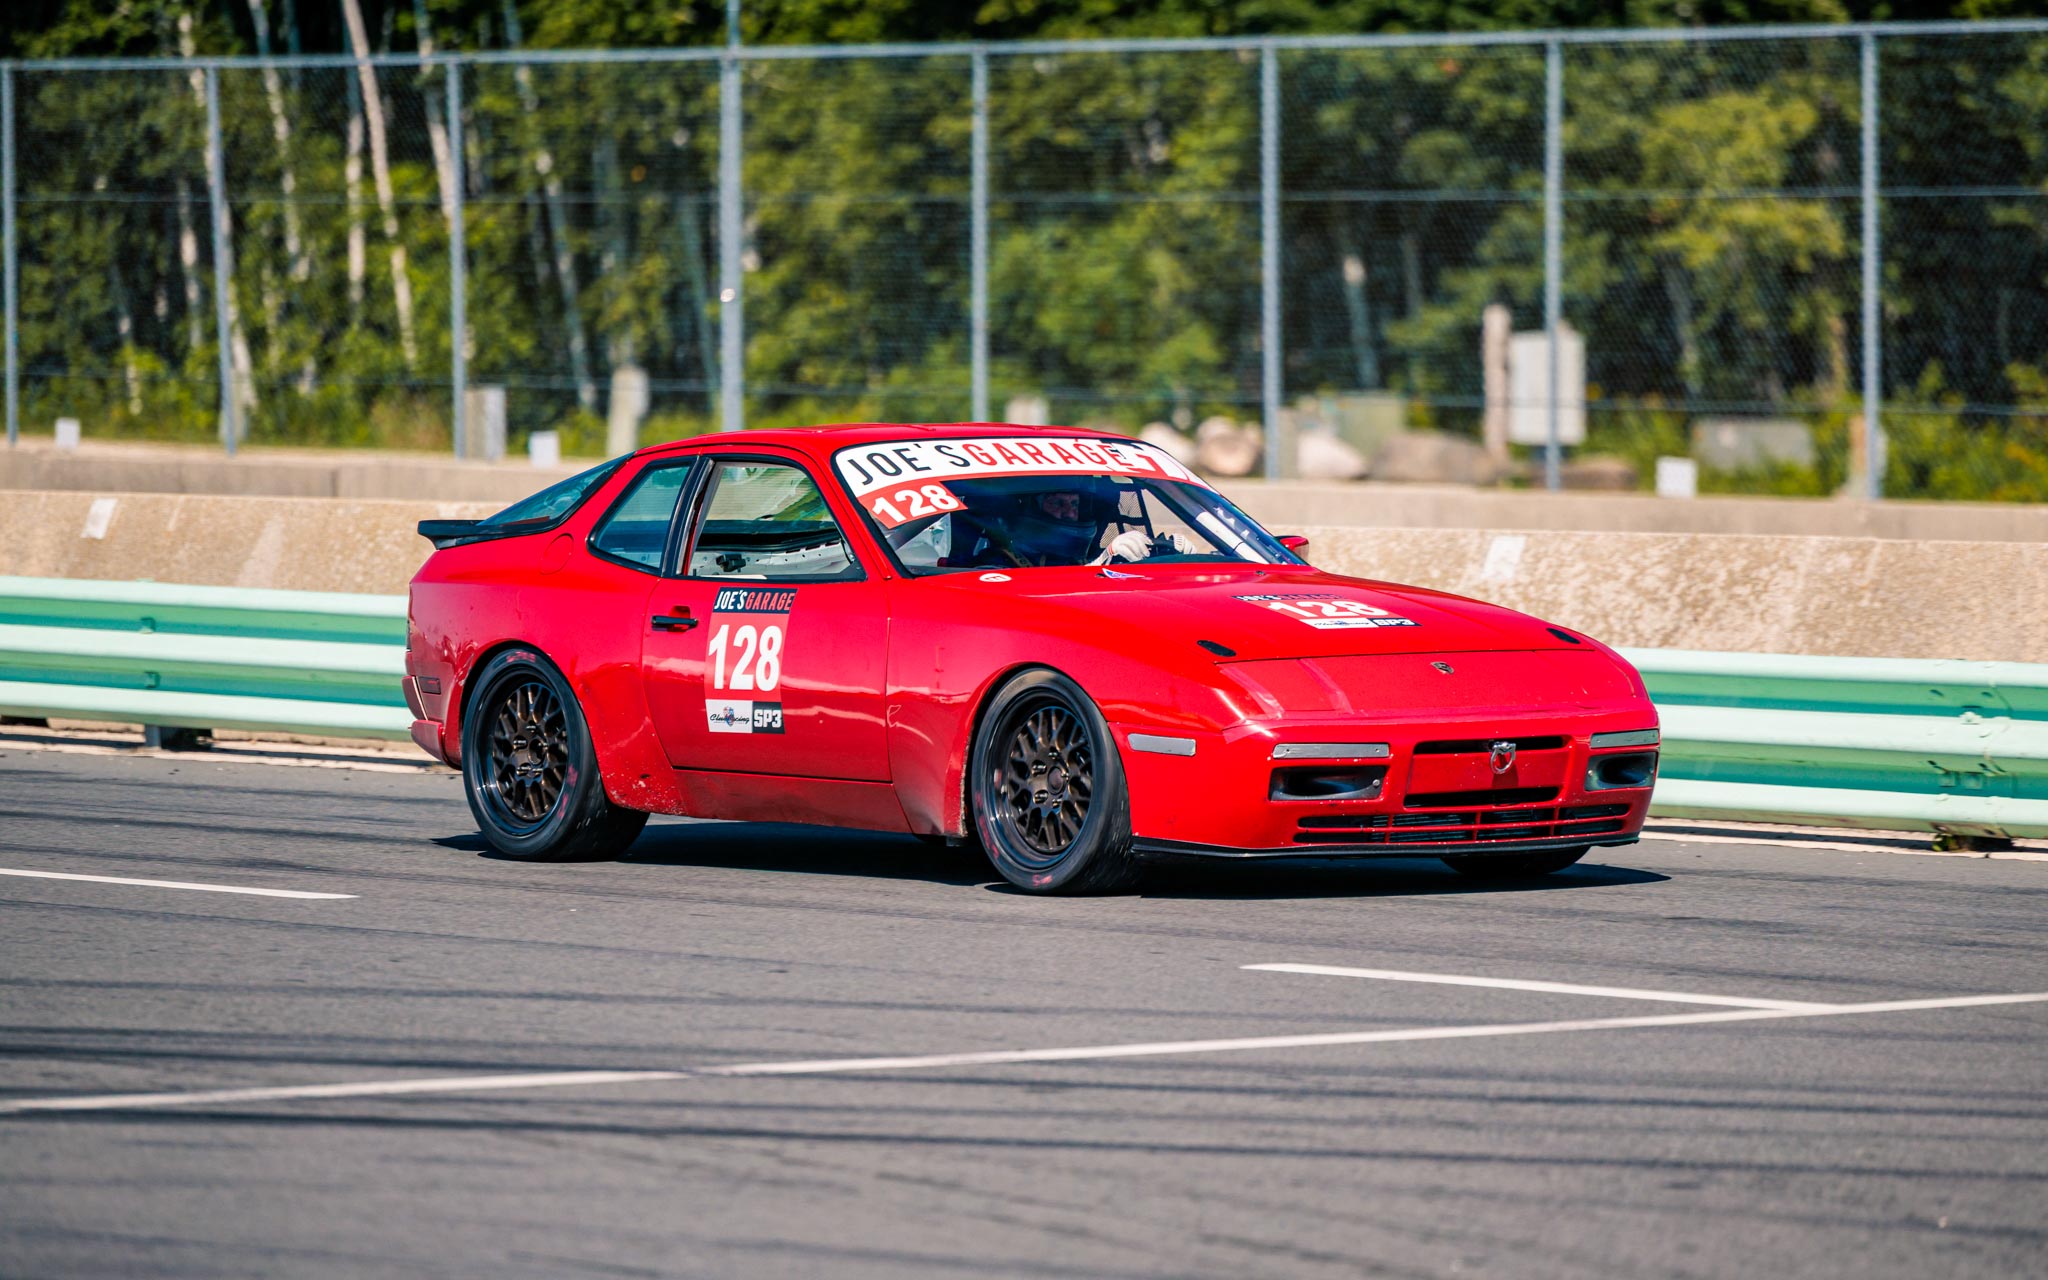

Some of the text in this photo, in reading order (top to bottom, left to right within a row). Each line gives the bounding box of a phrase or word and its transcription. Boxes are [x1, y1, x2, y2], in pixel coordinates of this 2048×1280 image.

[871, 484, 959, 523] 128
[1268, 600, 1388, 617] 128
[708, 624, 782, 692] 128
[754, 708, 782, 728] SP3
